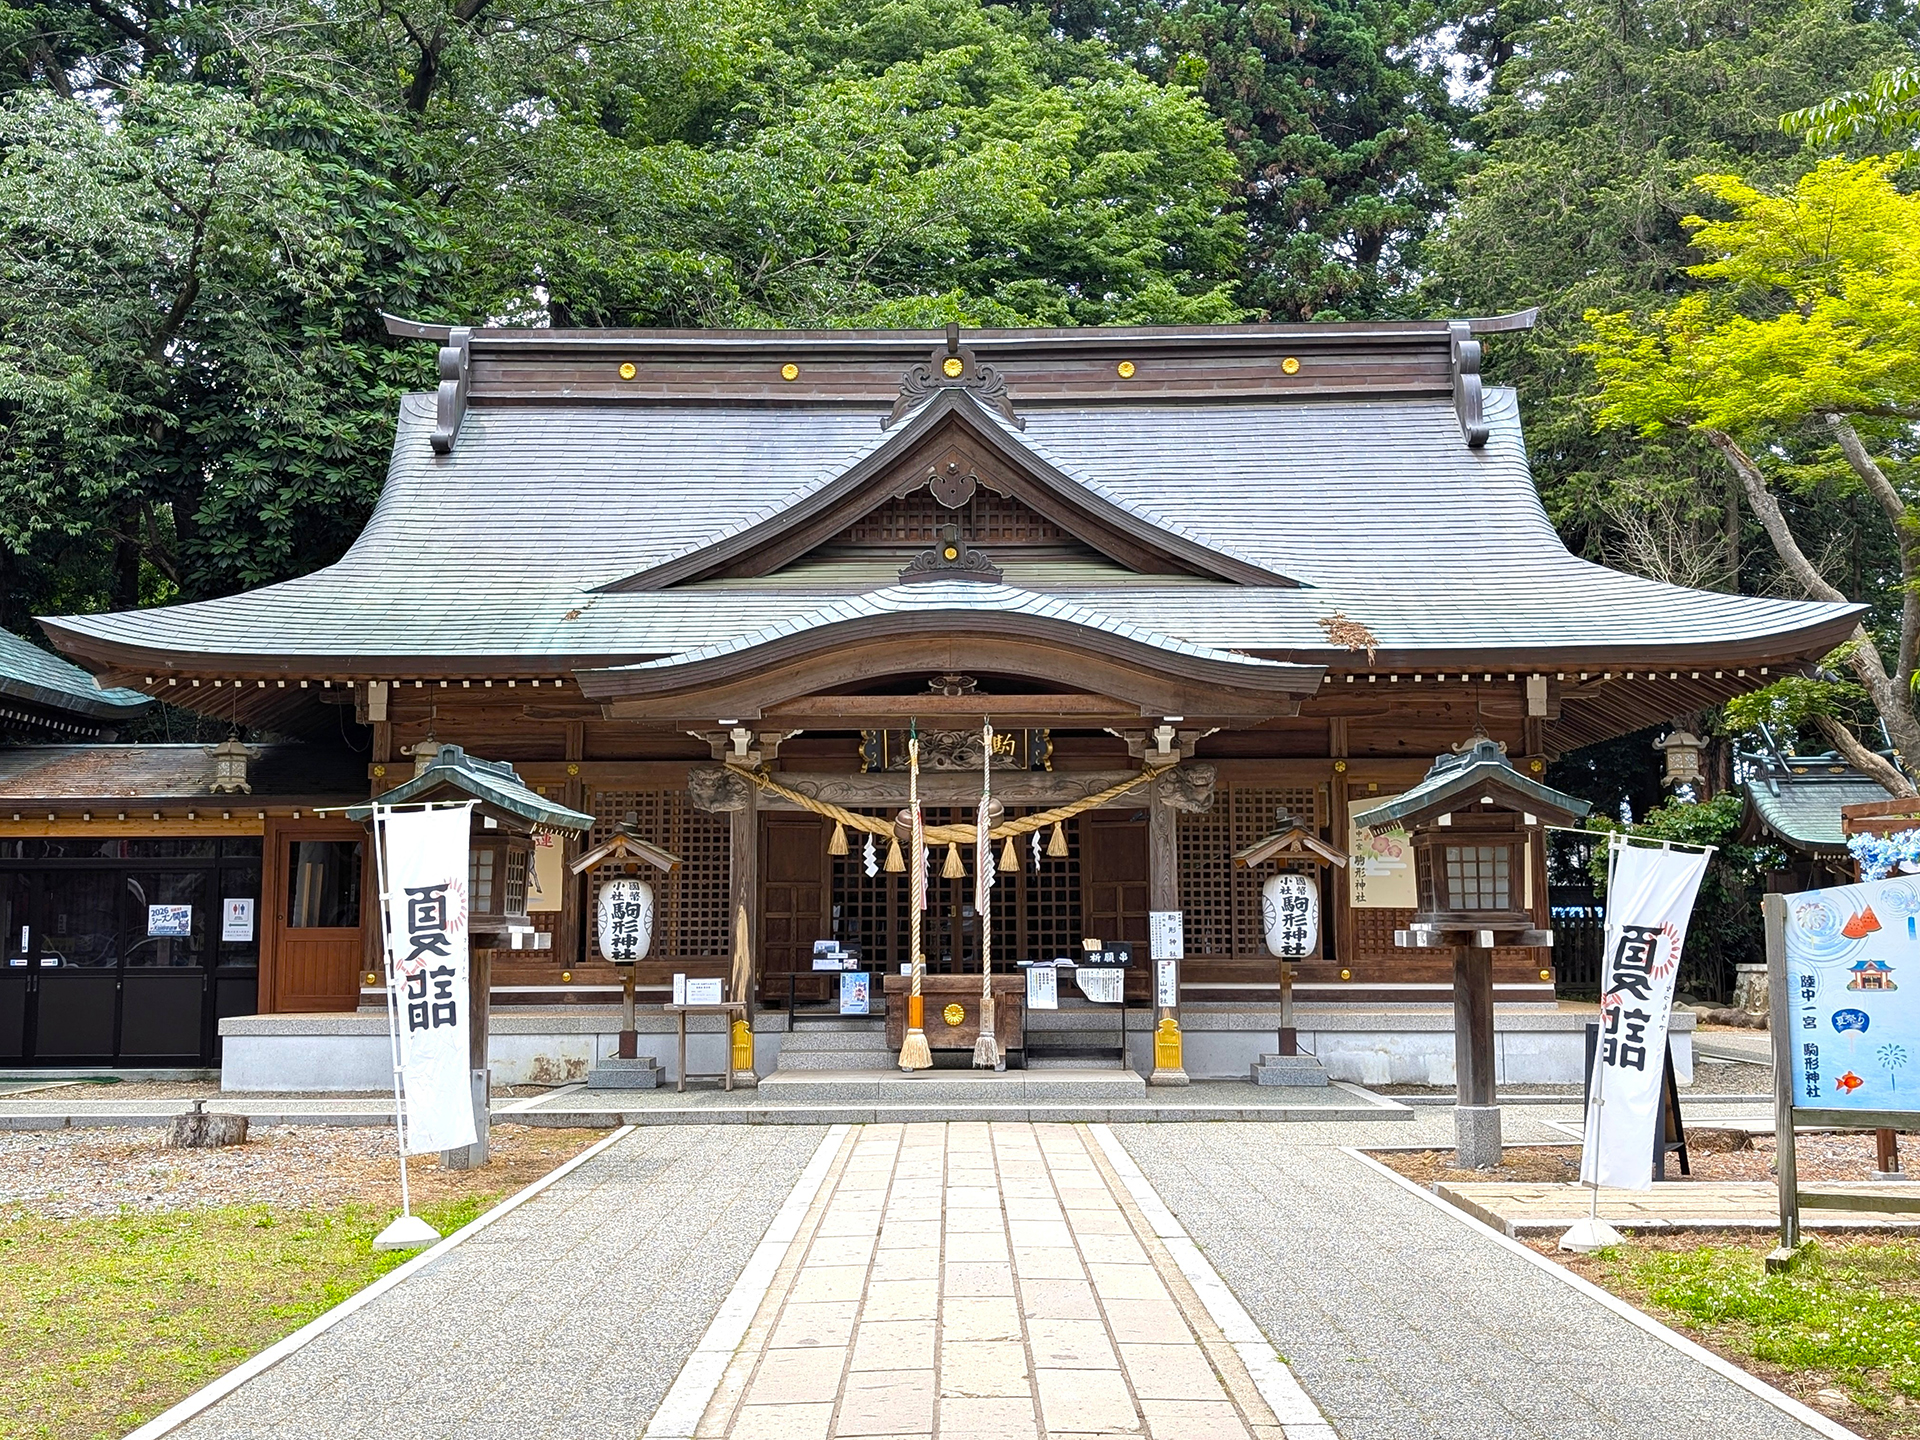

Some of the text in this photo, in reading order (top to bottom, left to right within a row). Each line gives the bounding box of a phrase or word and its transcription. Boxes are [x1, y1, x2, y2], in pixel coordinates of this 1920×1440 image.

[610, 882, 625, 901] 小社
[1280, 877, 1292, 895] 小社
[1354, 855, 1366, 903] 駒形神社
[611, 901, 641, 960] 駒形神社
[1281, 896, 1309, 956] 駒形神社
[1089, 951, 1128, 963] 祈願串
[1800, 975, 1821, 1098] 陸中一宮 駒形神社
[1836, 1014, 1865, 1026] 夏祭り
